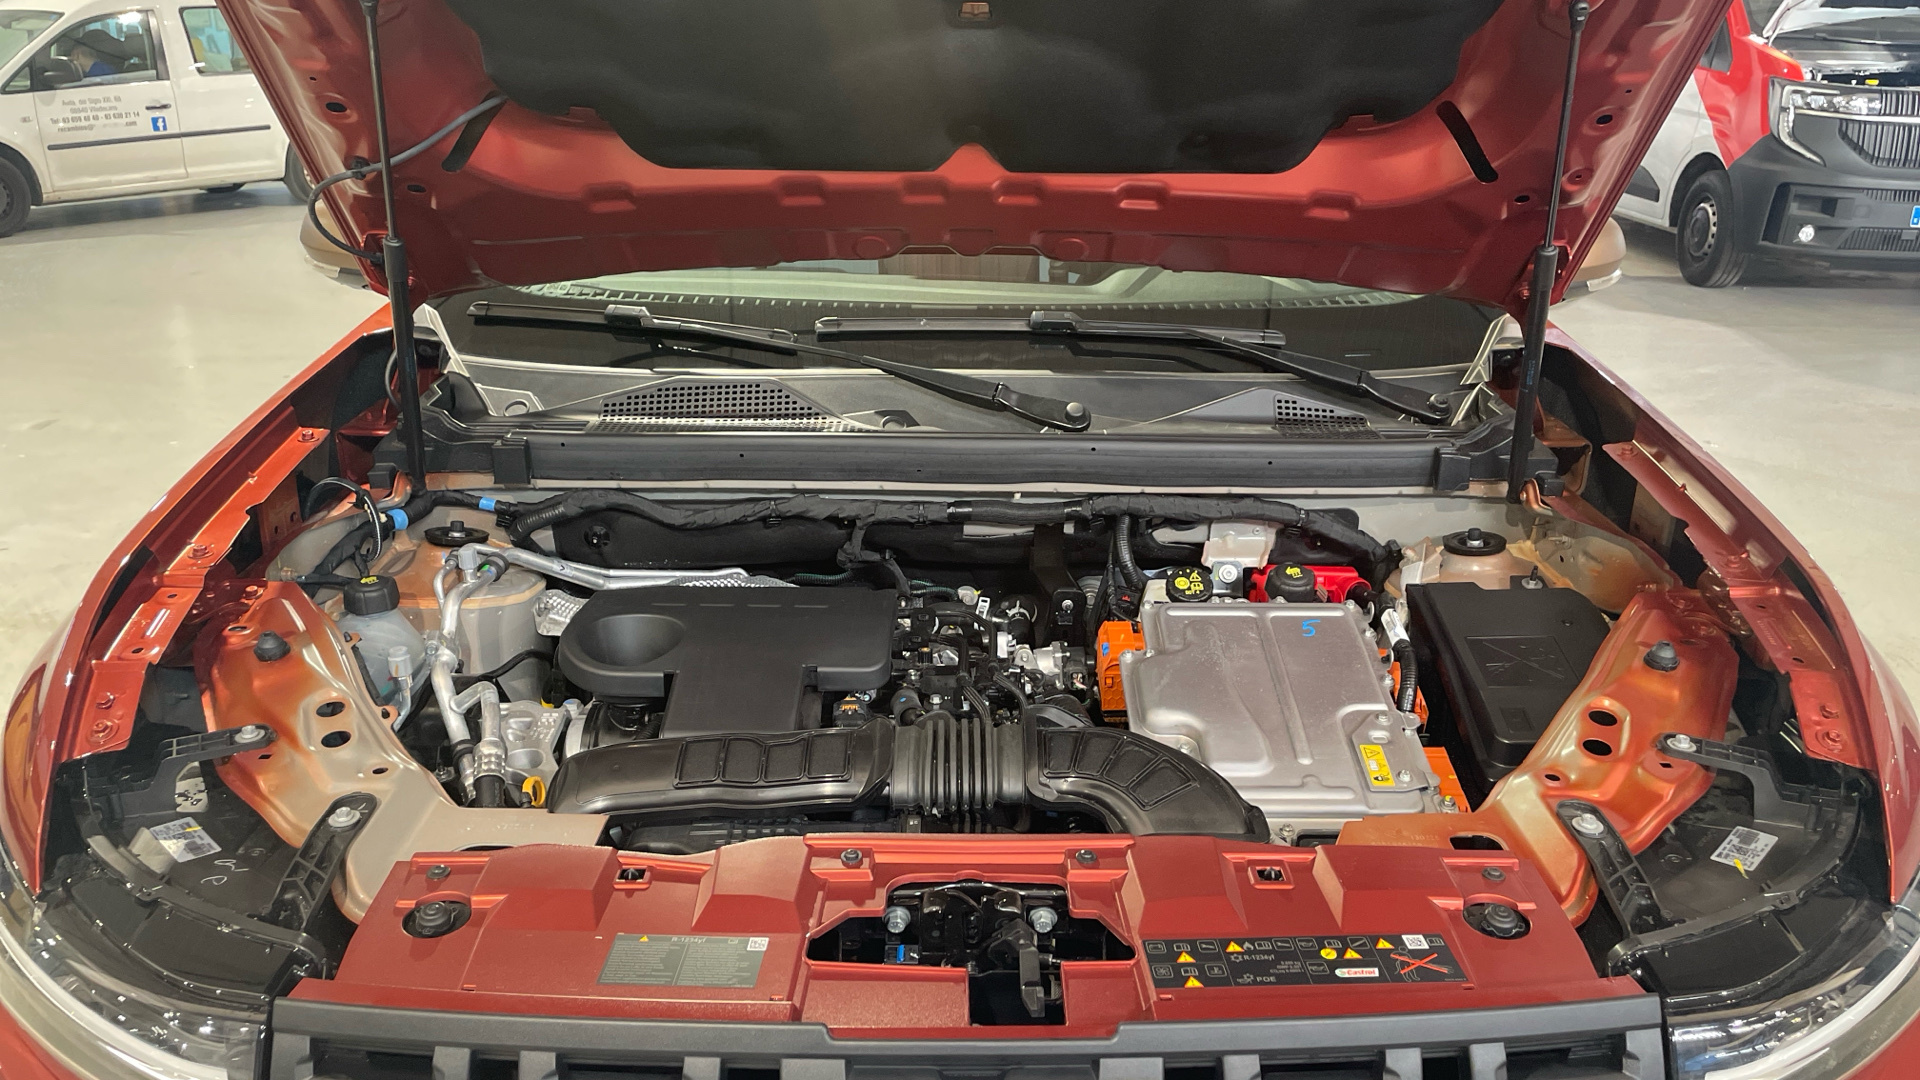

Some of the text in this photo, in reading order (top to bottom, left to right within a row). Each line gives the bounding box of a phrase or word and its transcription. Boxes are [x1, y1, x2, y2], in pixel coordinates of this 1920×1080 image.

[87, 97, 102, 105] Siglo
[124, 111, 132, 119] 21
[133, 110, 140, 118] 14
[1301, 619, 1321, 638] 5
[1243, 954, 1275, 962] R-1234yf
[1346, 968, 1376, 976] Castrol
